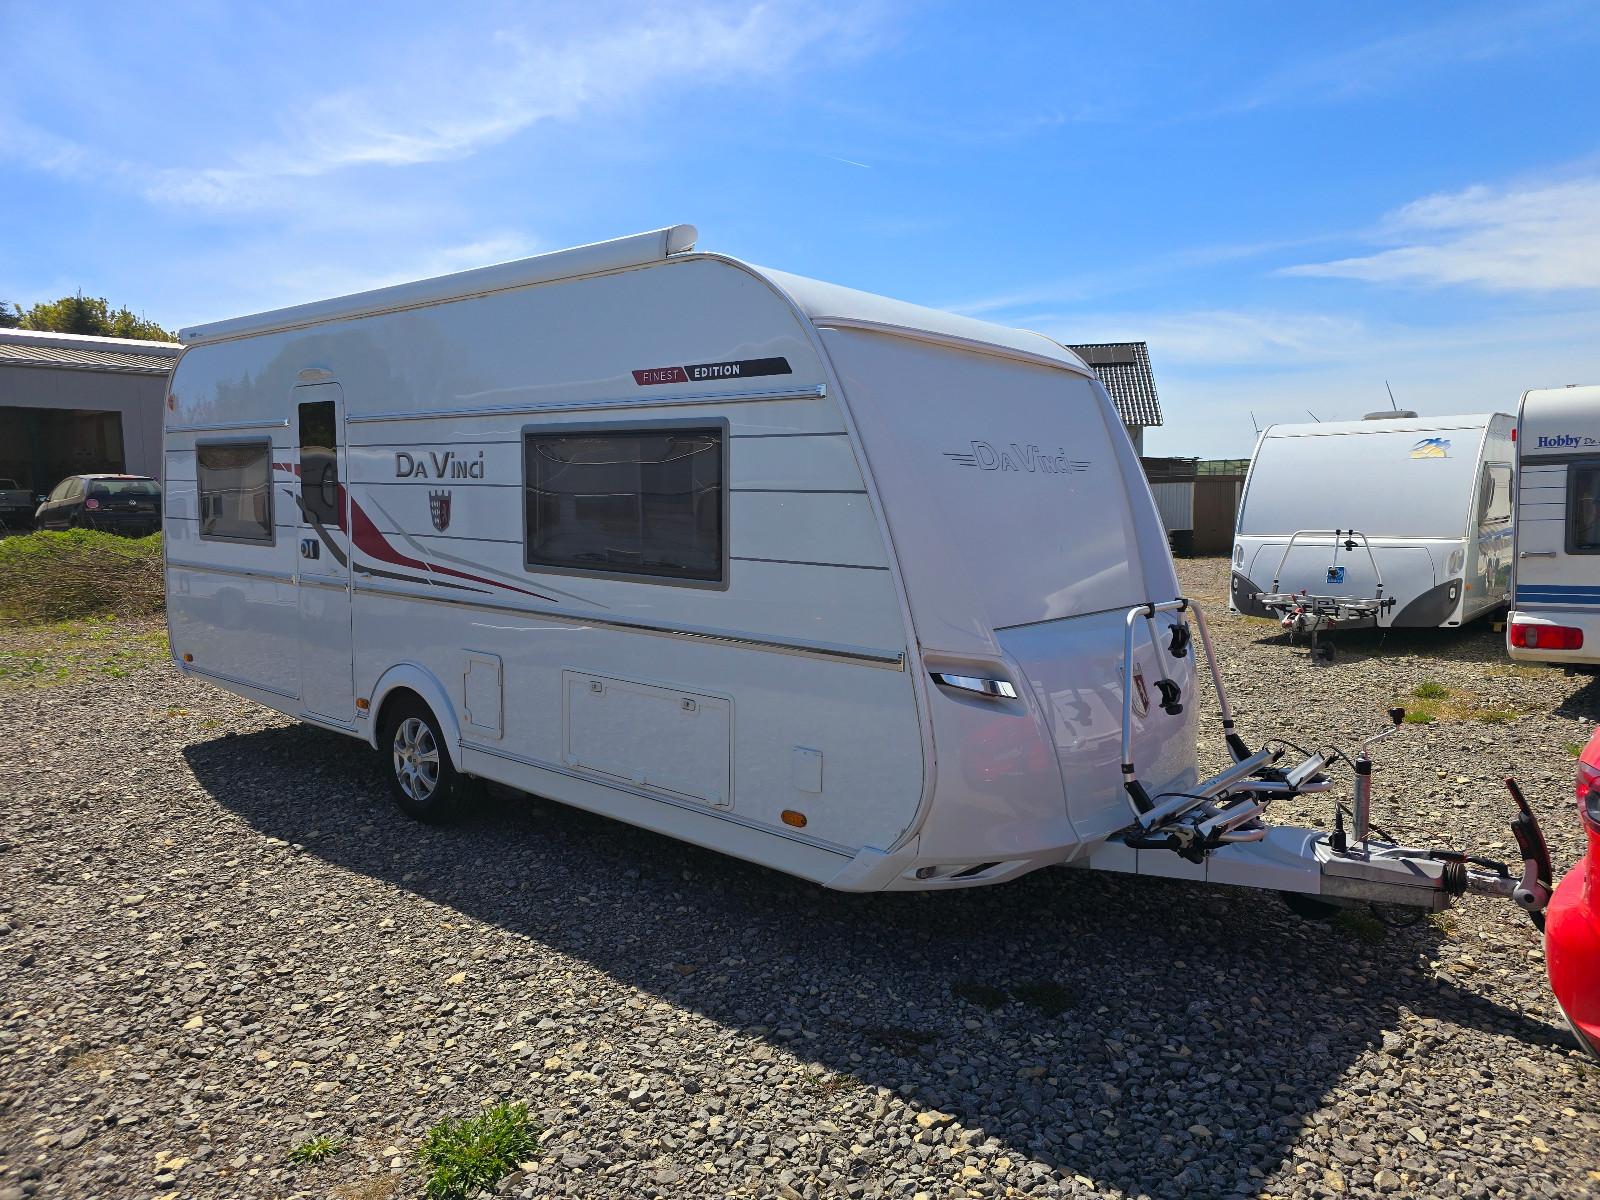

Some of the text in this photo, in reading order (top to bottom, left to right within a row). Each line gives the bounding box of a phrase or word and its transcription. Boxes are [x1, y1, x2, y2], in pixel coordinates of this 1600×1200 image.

[643, 364, 740, 382] FINEST EDITION
[1537, 434, 1582, 448] Hobby
